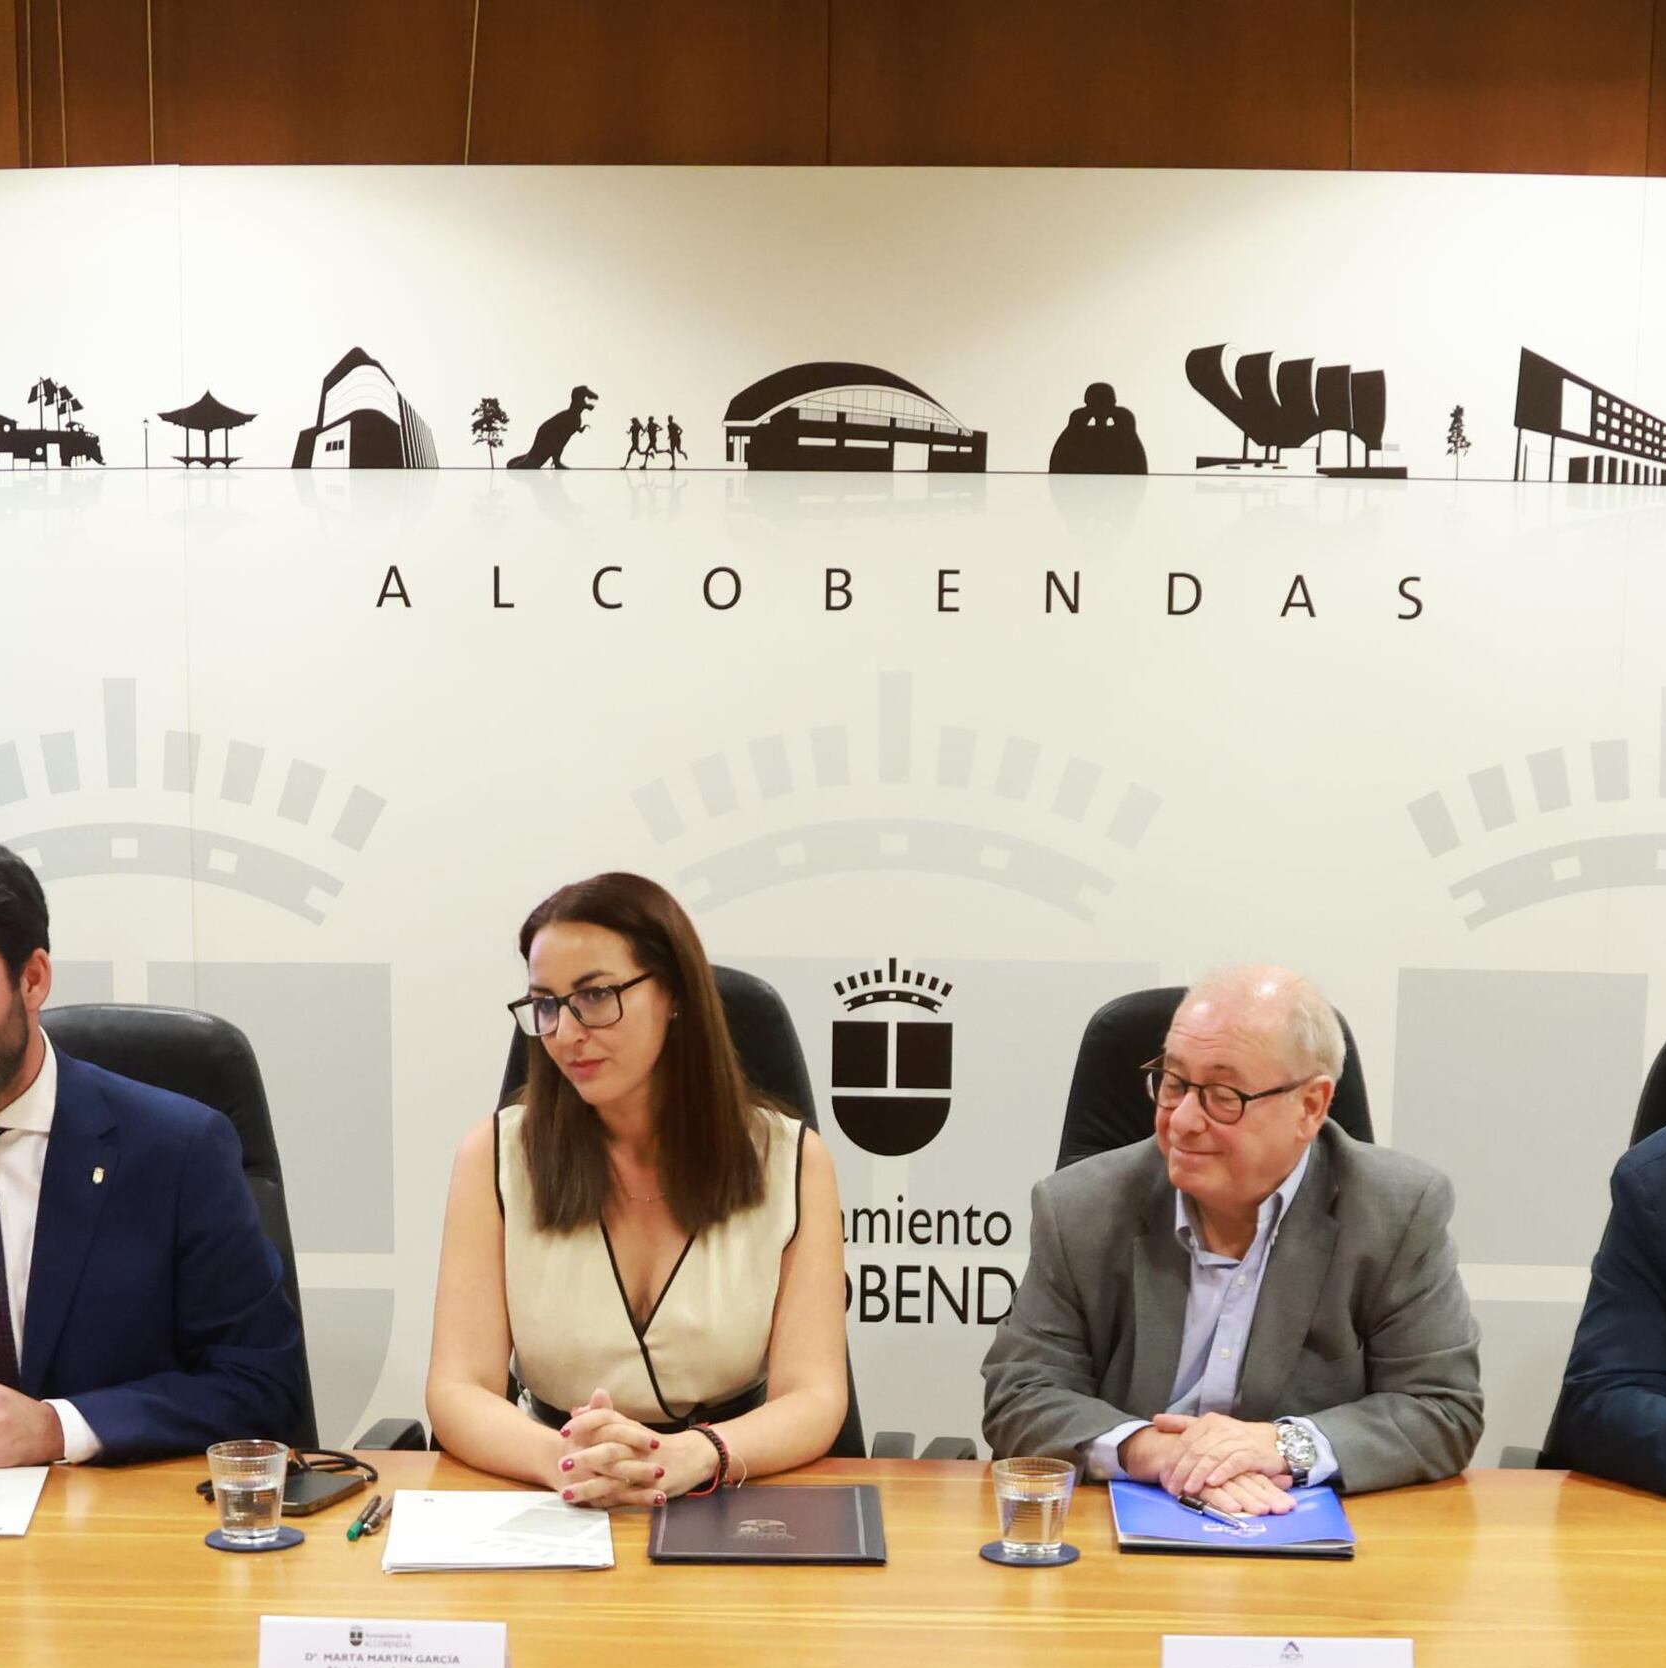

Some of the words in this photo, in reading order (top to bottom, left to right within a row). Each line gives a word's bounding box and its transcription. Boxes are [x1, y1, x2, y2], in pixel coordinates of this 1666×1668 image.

[376, 565, 1424, 621] ALCOBENDAS
[845, 1264, 1018, 1325] BEND
[323, 1653, 364, 1662] MARTA
[367, 1652, 413, 1663] MARTÍN
[415, 1653, 460, 1664] GARCÍA
